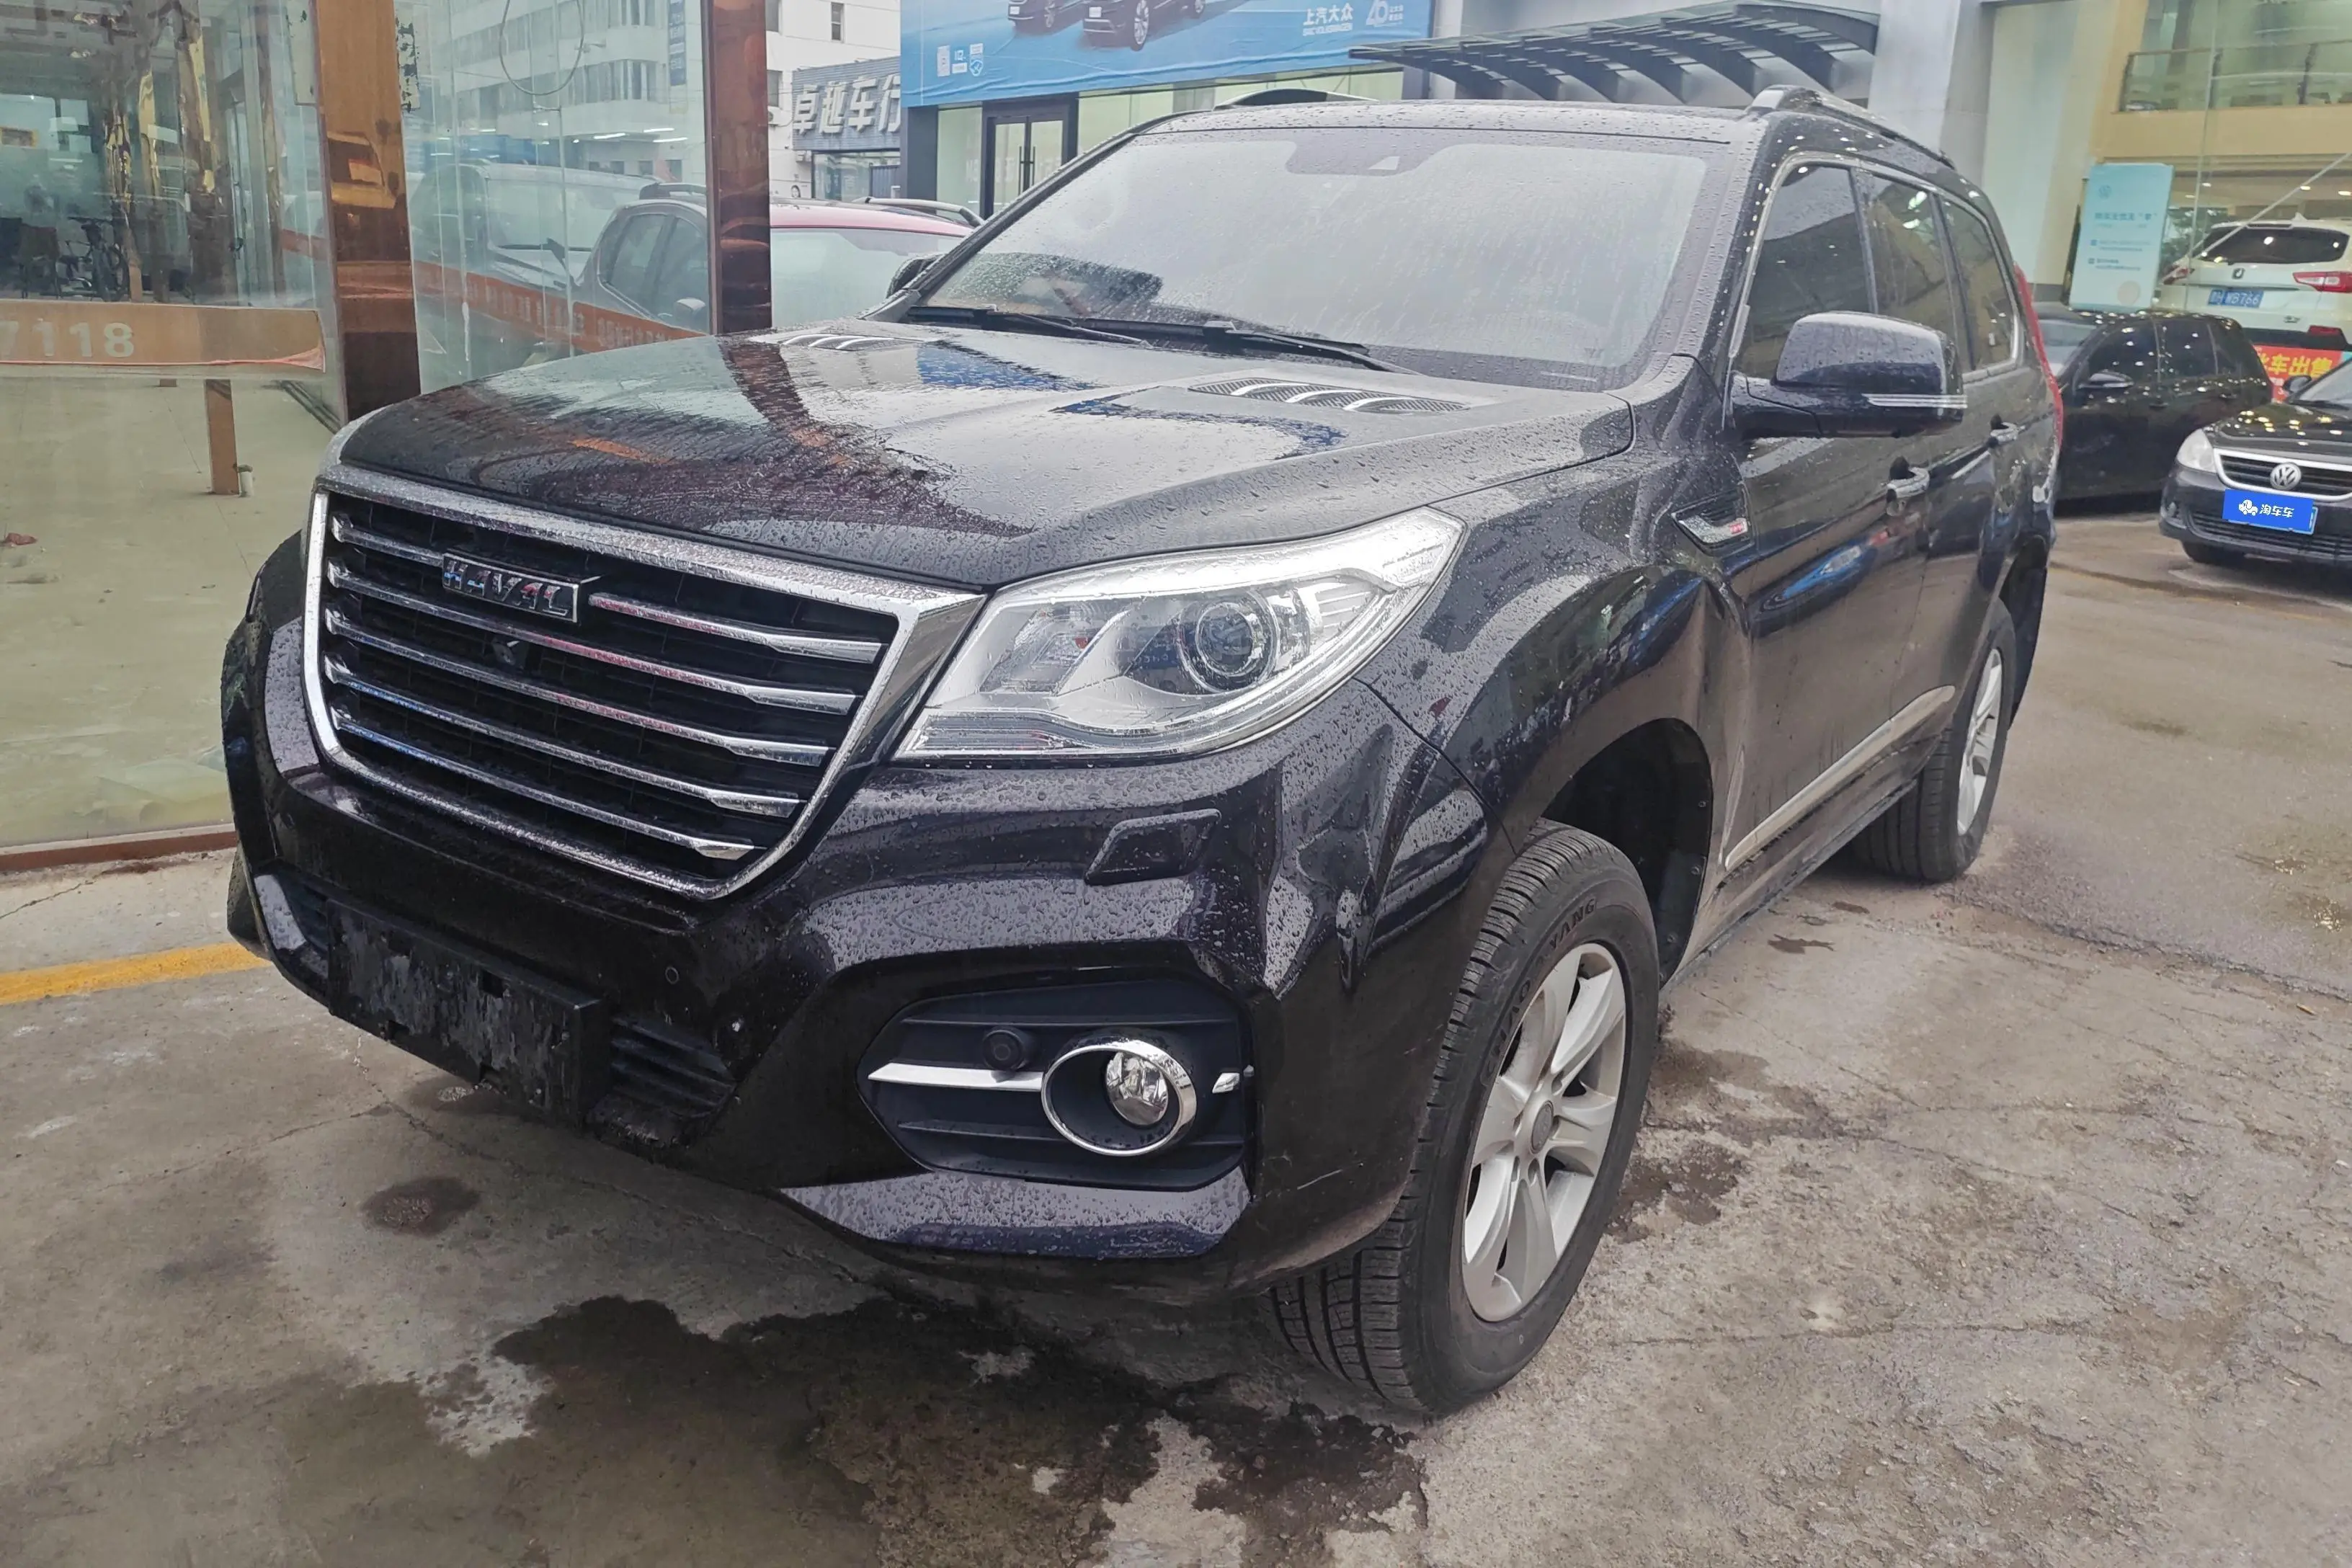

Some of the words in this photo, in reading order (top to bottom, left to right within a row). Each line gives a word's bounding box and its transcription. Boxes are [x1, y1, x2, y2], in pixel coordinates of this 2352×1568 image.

[1303, 3, 1353, 25] 上汽大众
[0, 321, 135, 357] 7118
[443, 560, 570, 617] HAVAL
